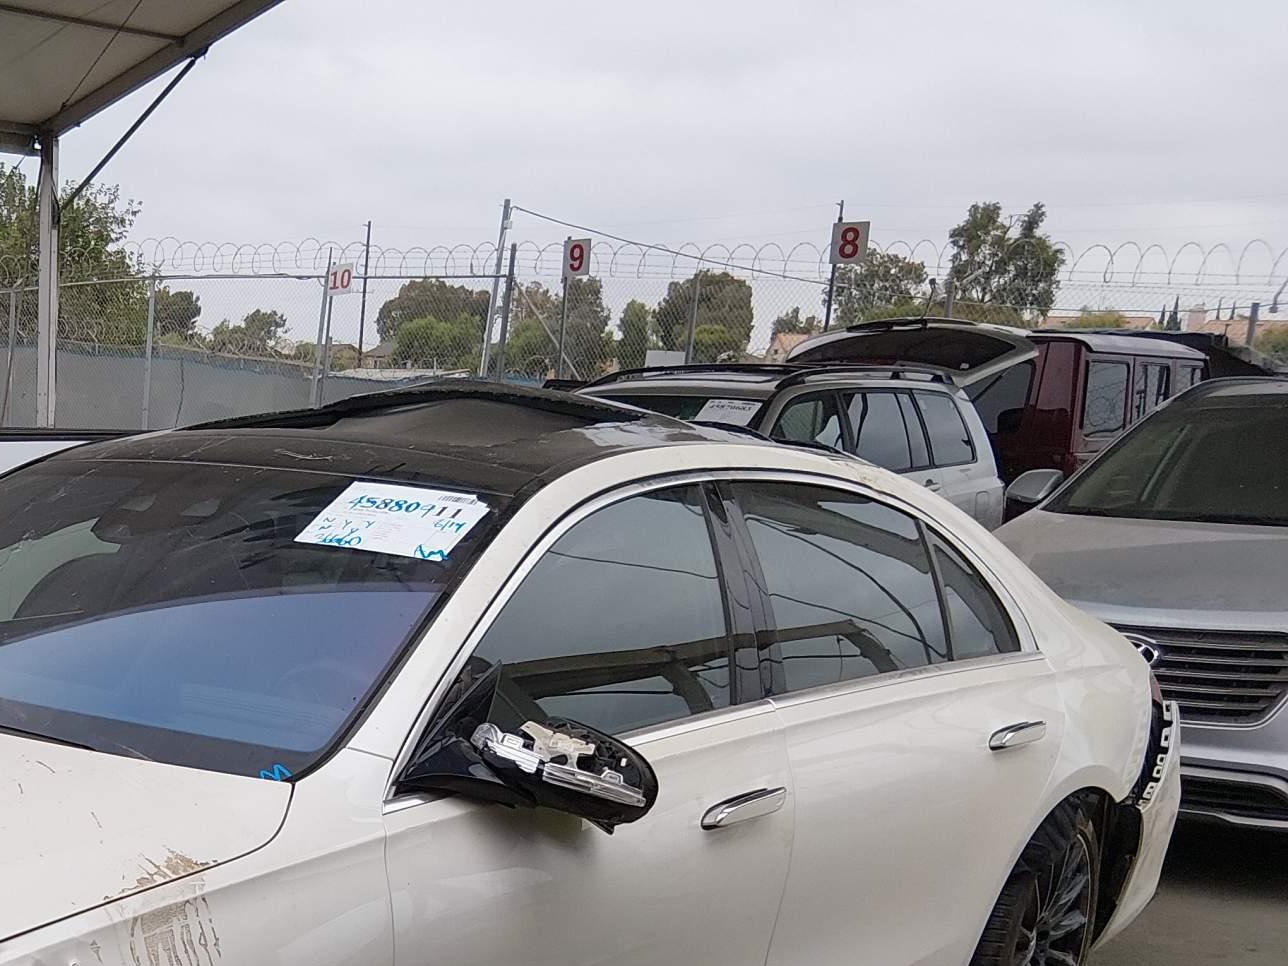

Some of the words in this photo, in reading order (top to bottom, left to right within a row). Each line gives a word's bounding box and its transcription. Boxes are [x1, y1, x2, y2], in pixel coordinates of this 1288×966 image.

[839, 227, 859, 258] 8
[570, 244, 584, 271] 9
[329, 269, 351, 290] 10
[348, 494, 463, 518] 45880911
